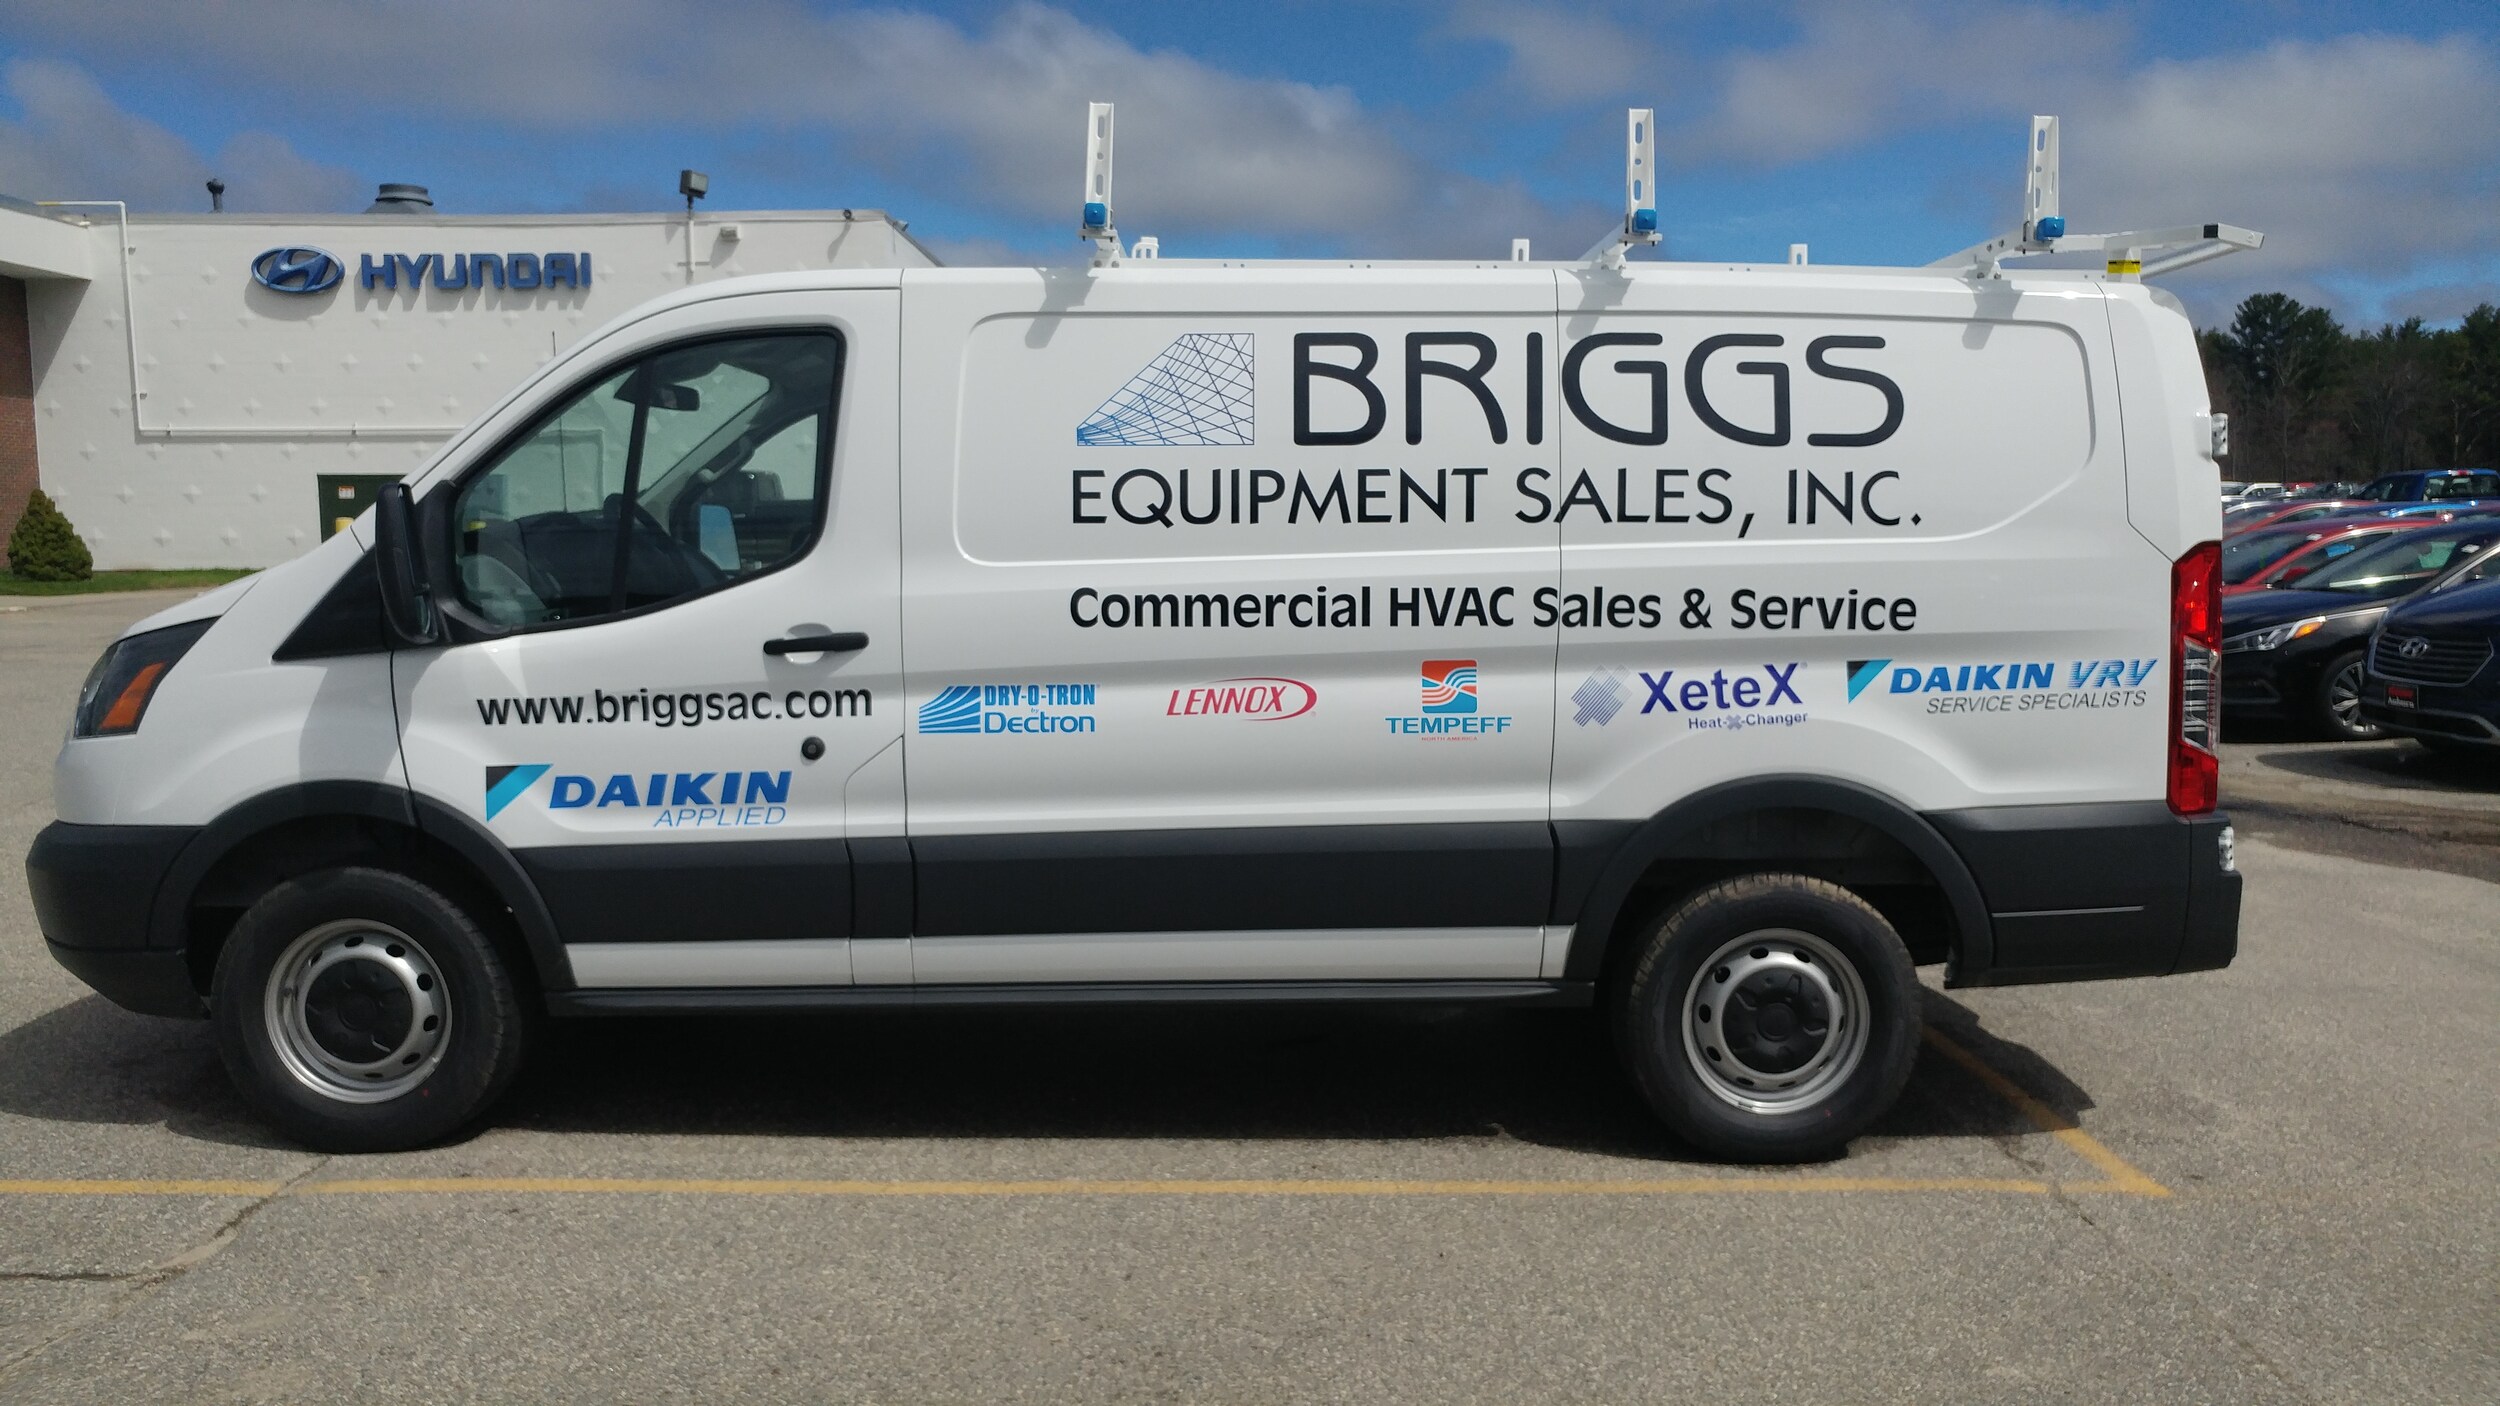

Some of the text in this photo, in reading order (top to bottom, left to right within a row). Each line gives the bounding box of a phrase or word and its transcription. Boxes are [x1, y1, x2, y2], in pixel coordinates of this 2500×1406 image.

[361, 252, 592, 289] HYUNDAI
[1292, 332, 1905, 447] BRIGGS
[1073, 468, 1922, 538] EQUIPMENT SALES, INC.
[1070, 586, 1918, 632] Commercial HVAC Sales & Service
[1638, 661, 1804, 715] XeteX
[1888, 658, 2158, 694] DAIKIN VRV
[477, 687, 874, 728] www.briggsac.com
[984, 684, 1096, 706] DRY-O-TRON
[1166, 685, 1288, 716] LENNOX
[1926, 689, 2148, 715] SERVICE SPECIALISTS
[984, 711, 1096, 734] Dectron
[1384, 716, 1513, 734] TEMPEFF
[549, 770, 793, 809] DAIKIN
[653, 806, 787, 828] APPLIED
